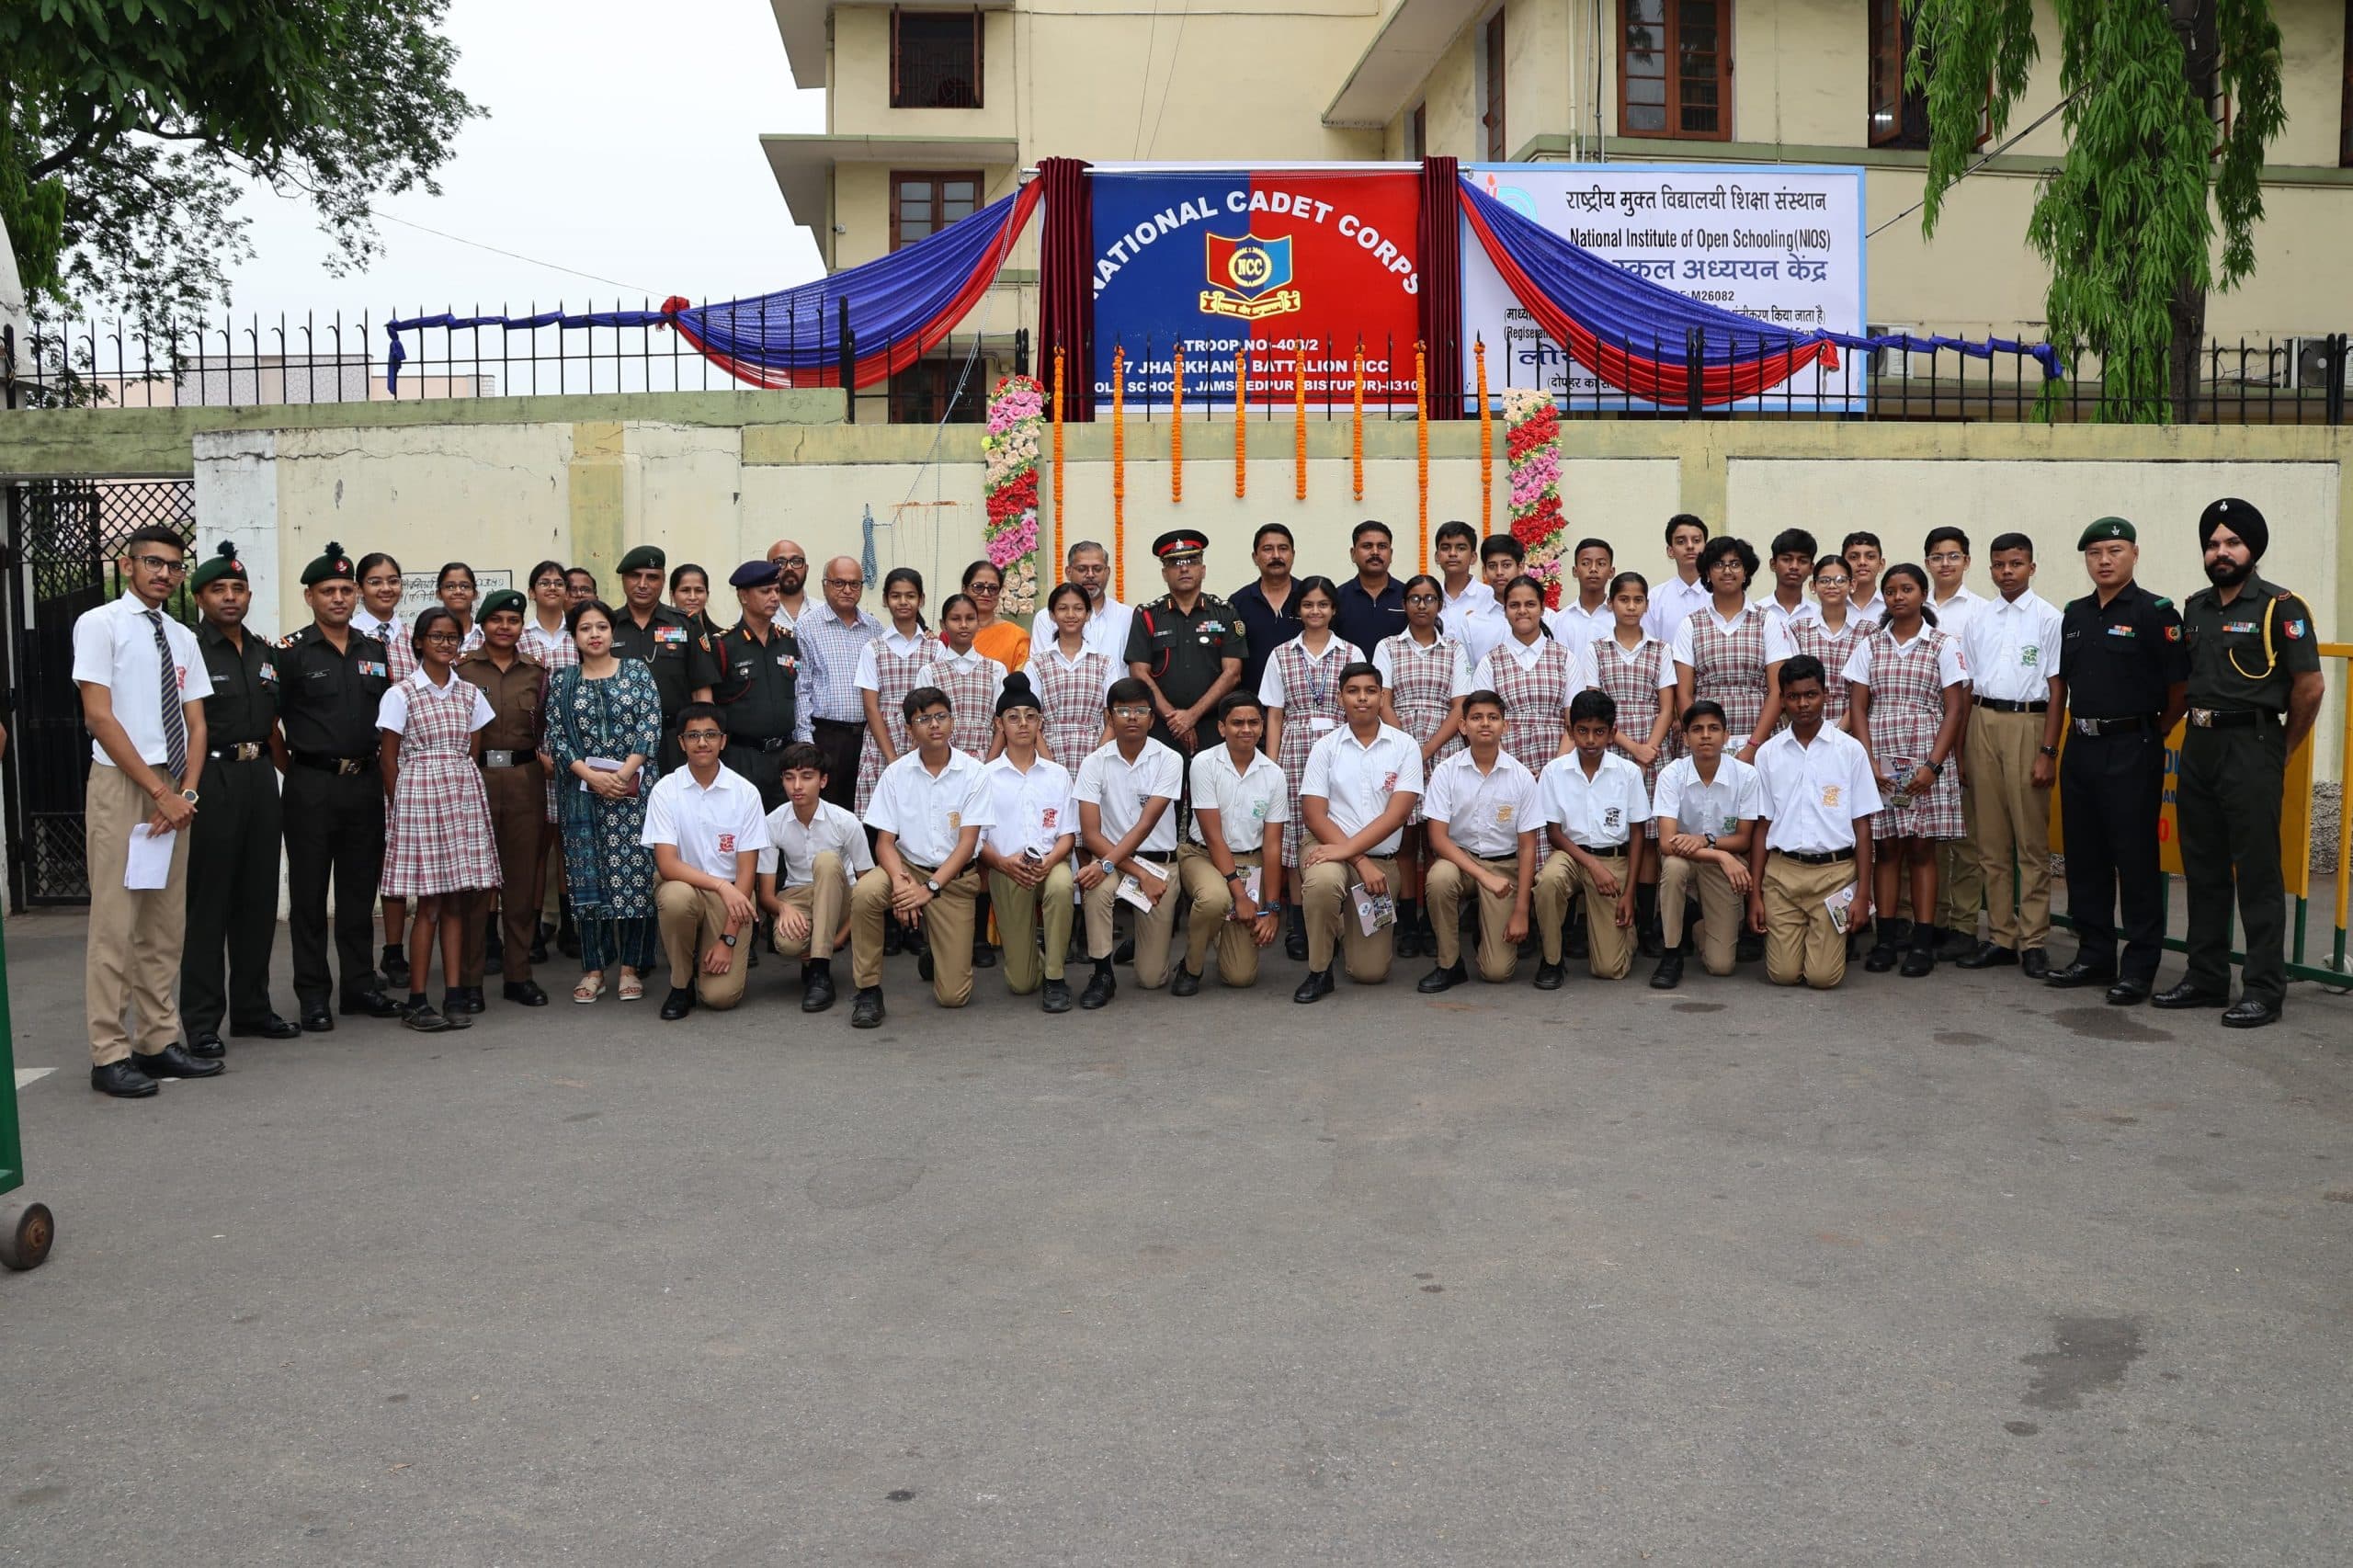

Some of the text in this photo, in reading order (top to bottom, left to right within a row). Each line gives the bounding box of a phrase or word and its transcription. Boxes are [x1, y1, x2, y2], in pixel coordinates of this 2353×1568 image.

[1566, 184, 1826, 217] राष्ट्रीय मुक्त विद्यालयी शिक्षा संस्थान
[1093, 190, 1419, 300] NATIONAL CADET CORPS
[1570, 228, 1622, 247] National
[1626, 228, 1677, 247] Institute
[1681, 229, 1693, 247] of
[1697, 229, 1728, 252] Open
[1237, 258, 1263, 276] NCC
[1683, 259, 1779, 280] अध्ययन
[1787, 253, 1828, 282] केंद्र
[1771, 304, 1792, 322] किया
[1794, 310, 1814, 323] जाता
[1184, 340, 1239, 352] TROOP
[1196, 380, 1294, 392] JAMSEDPUR
